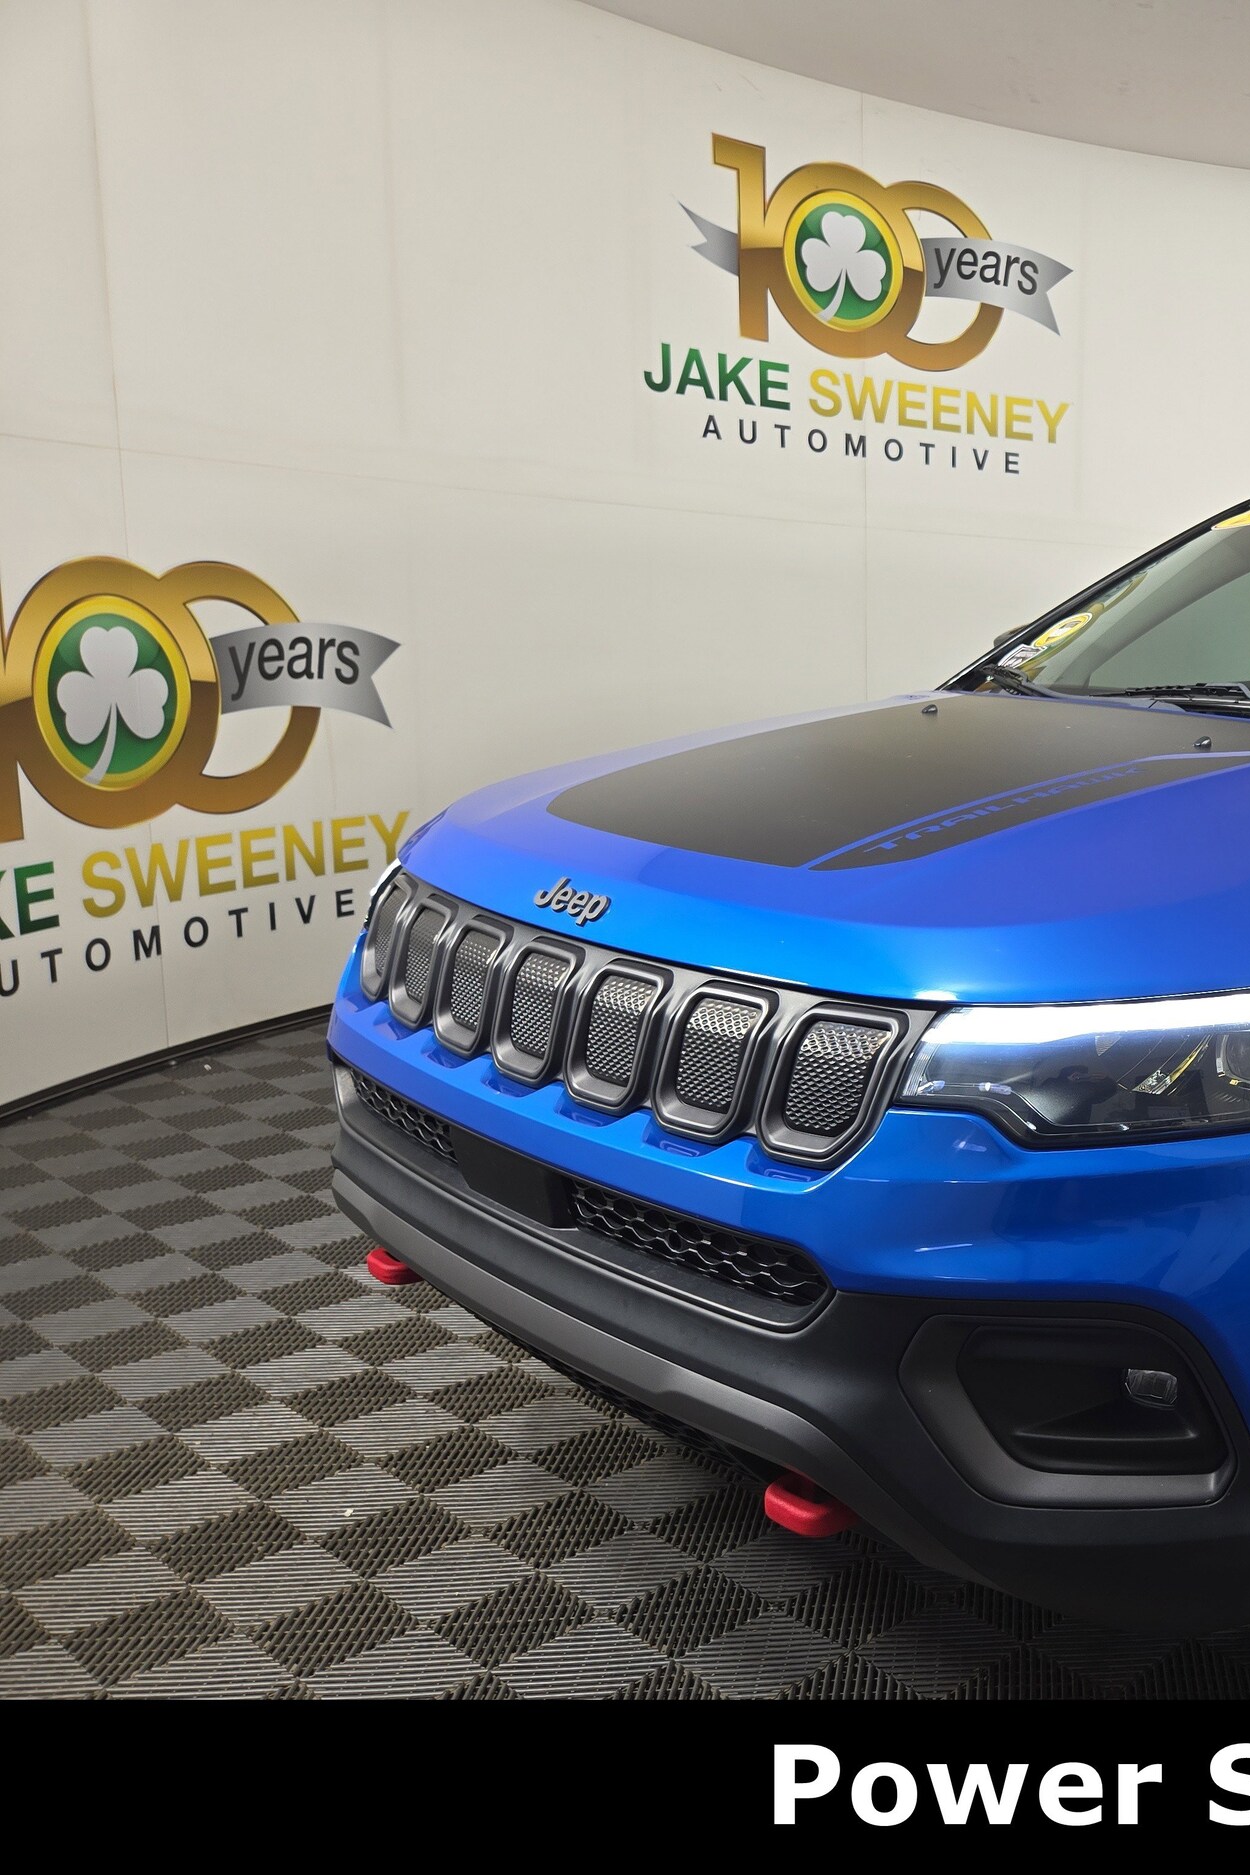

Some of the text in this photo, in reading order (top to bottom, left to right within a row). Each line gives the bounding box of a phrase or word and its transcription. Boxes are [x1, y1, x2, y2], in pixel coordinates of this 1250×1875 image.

[933, 245, 1039, 296] years
[643, 341, 1071, 444] JAKE SWEENEY
[701, 413, 1020, 475] AUTOMOTIVE
[228, 635, 360, 701] years
[863, 766, 1149, 854] TRAILHAWK
[81, 810, 411, 919] SWEENEY
[534, 876, 612, 927] Jeep
[0, 888, 356, 998] UTOMOTIVE
